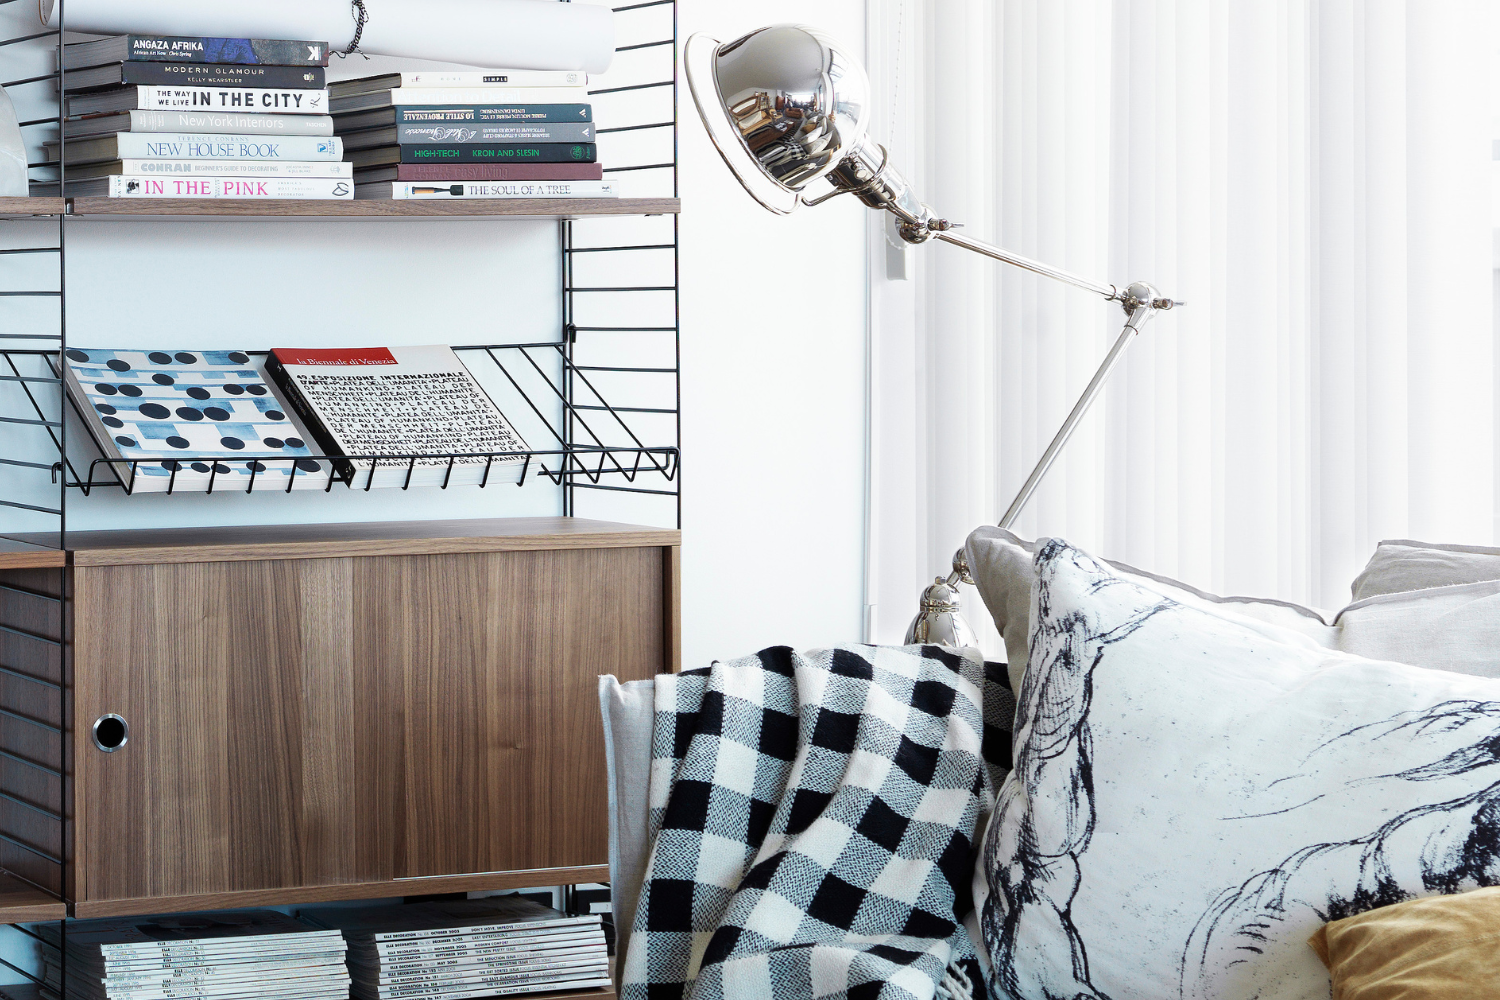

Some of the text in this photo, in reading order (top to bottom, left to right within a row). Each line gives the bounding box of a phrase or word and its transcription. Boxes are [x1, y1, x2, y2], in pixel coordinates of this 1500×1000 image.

[133, 40, 203, 51] ANGAZA AFRIKA
[165, 66, 209, 74] MODERN
[193, 92, 303, 108] IN THE CITY
[179, 115, 205, 127] New
[207, 115, 233, 127] York
[235, 116, 284, 129] Interiors
[147, 143, 279, 157] NEW HOUSE BOOK
[414, 149, 540, 158] HIGH-TECH KRON AND SLESIN
[141, 163, 192, 172] CONRAN
[455, 164, 508, 179] easy living
[145, 181, 164, 194] IN
[173, 181, 211, 195] THE
[224, 181, 268, 195] PINK
[468, 185, 571, 195] THE SOUL OF A TREE
[307, 358, 347, 366] Biennale
[350, 357, 358, 365] di
[359, 357, 396, 365] Venezia
[380, 372, 466, 381] INTERNAZIONALE
